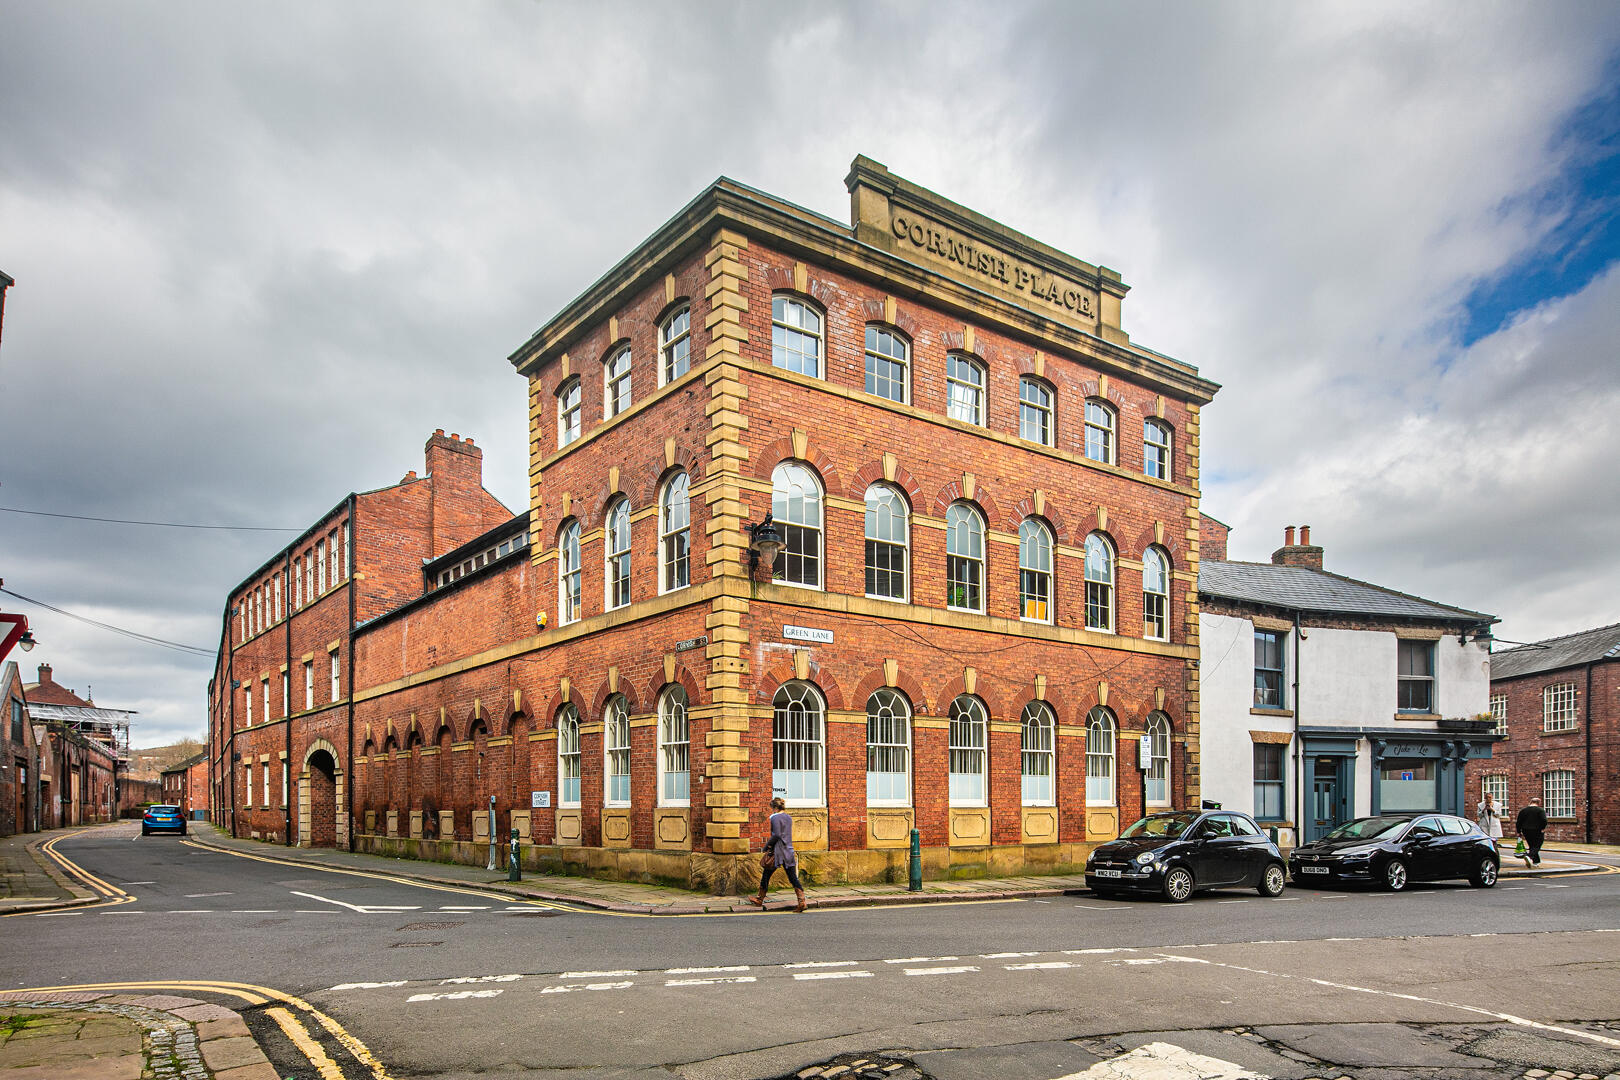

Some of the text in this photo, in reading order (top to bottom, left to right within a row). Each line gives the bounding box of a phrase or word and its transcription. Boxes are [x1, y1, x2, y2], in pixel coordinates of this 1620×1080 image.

[891, 215, 1010, 285] CORNISH
[785, 628, 829, 640] GREEN LANE
